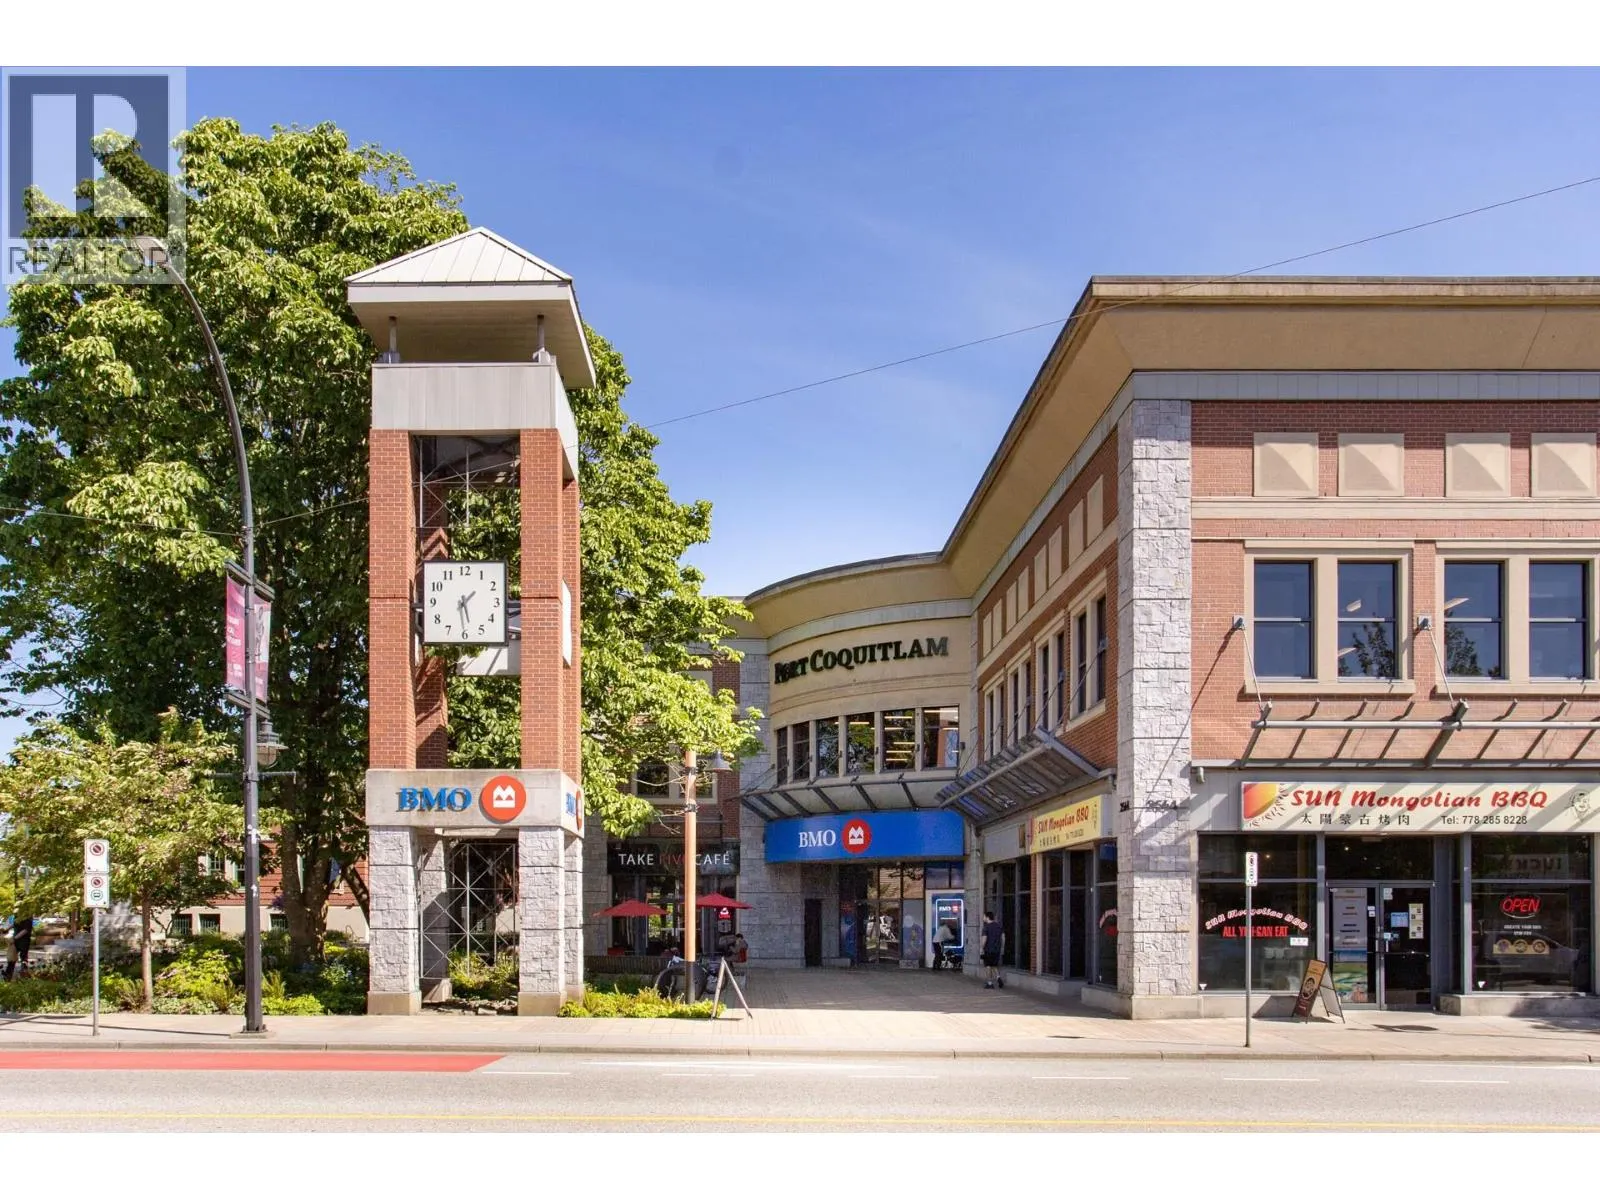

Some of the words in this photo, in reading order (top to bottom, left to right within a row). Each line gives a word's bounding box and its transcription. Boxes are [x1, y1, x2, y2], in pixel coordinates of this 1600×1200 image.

[443, 570, 453, 580] 11
[460, 565, 471, 576] 12
[480, 570, 484, 580] 1
[432, 581, 443, 591] 10
[490, 581, 496, 591] 2
[430, 597, 437, 607] 9
[494, 597, 500, 607] 3
[434, 614, 441, 624] 8
[488, 613, 494, 623] 4
[445, 625, 452, 636] 7
[462, 630, 468, 640] 6
[478, 625, 485, 635] 5
[397, 786, 472, 811] BMO
[1350, 789, 1481, 812] Mongolian
[1490, 790, 1548, 808] BBQ
[1441, 815, 1459, 825] Tel:
[1462, 815, 1480, 825] 778
[1483, 815, 1501, 825] 285
[1503, 815, 1528, 825] 8228
[798, 829, 836, 848] BMO
[618, 853, 655, 866] TAKE
[1502, 897, 1540, 913] OPEN
[1222, 926, 1236, 937] ALL
[1274, 926, 1289, 937] EAT
